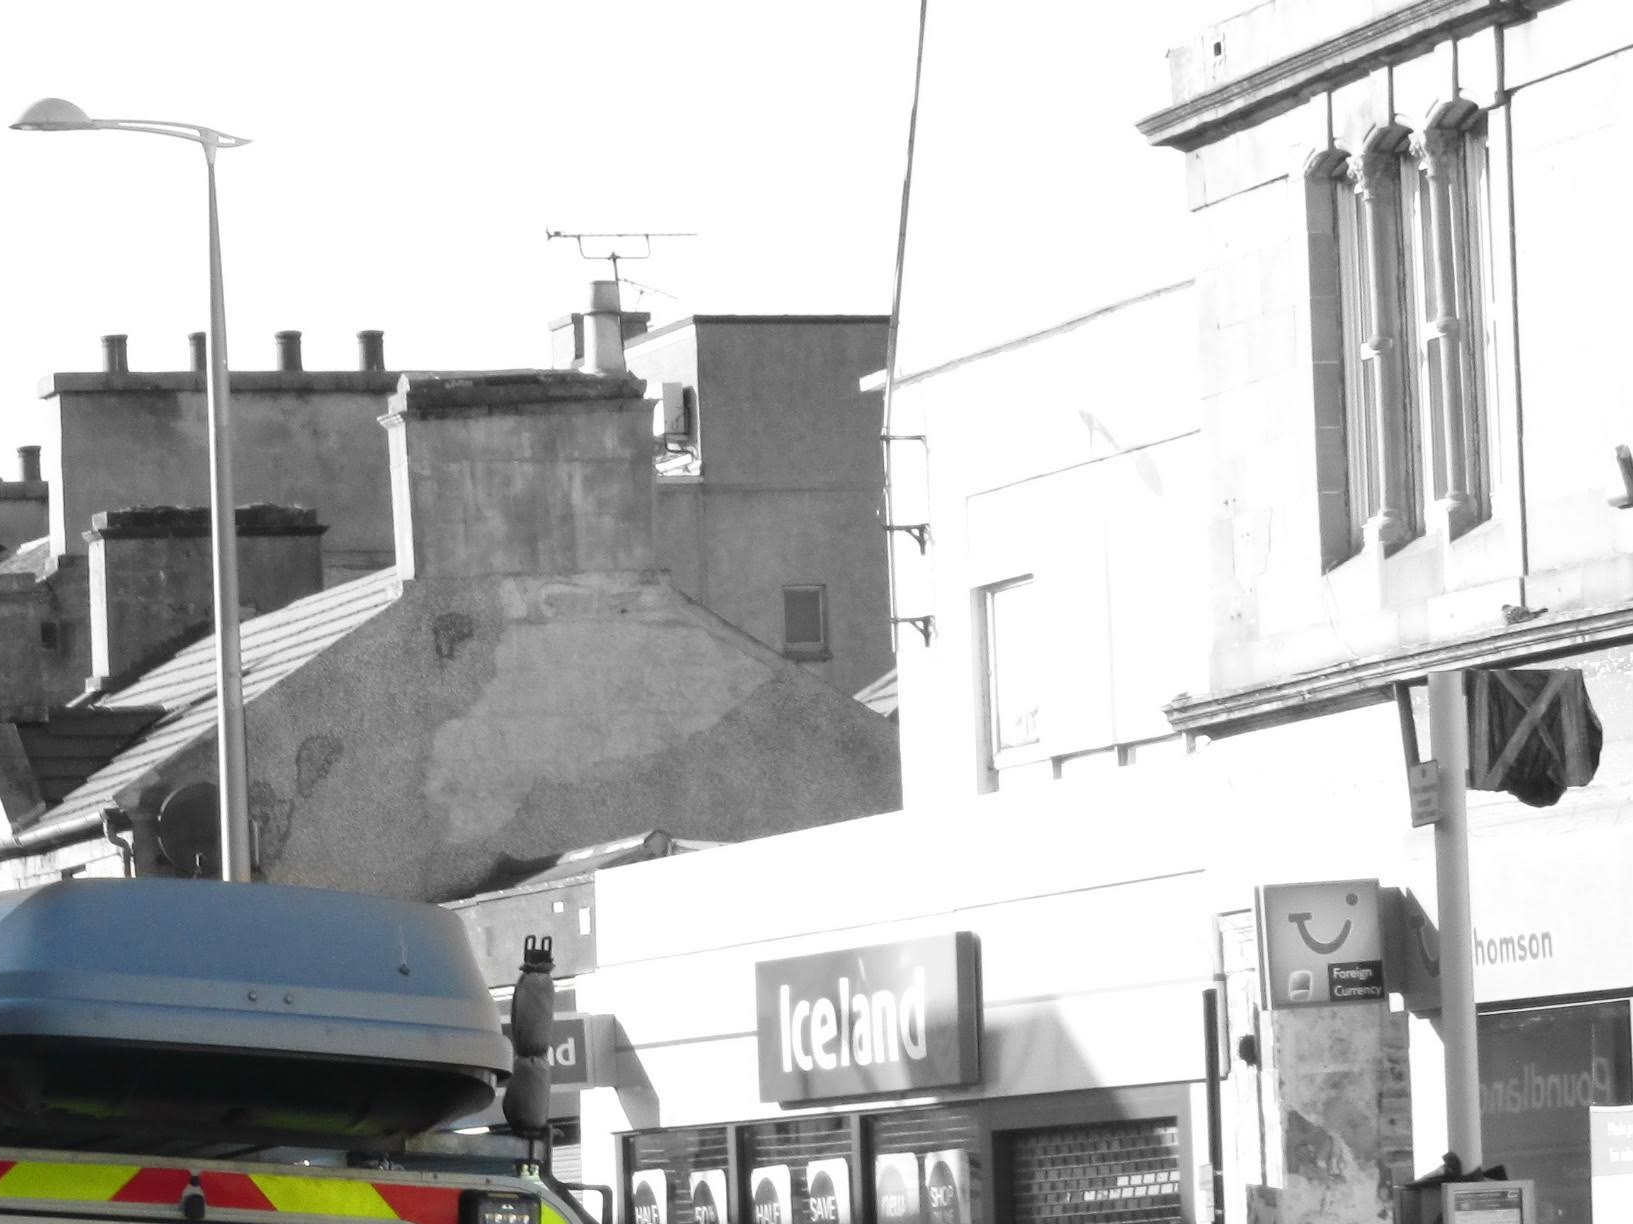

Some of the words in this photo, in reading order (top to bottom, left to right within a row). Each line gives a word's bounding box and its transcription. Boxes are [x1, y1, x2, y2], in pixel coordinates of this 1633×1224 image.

[1473, 927, 1553, 966] homson
[1332, 966, 1373, 980] Foreign
[1334, 984, 1382, 997] Currency
[779, 965, 928, 1073] Iceland
[809, 1196, 836, 1222] SAVE
